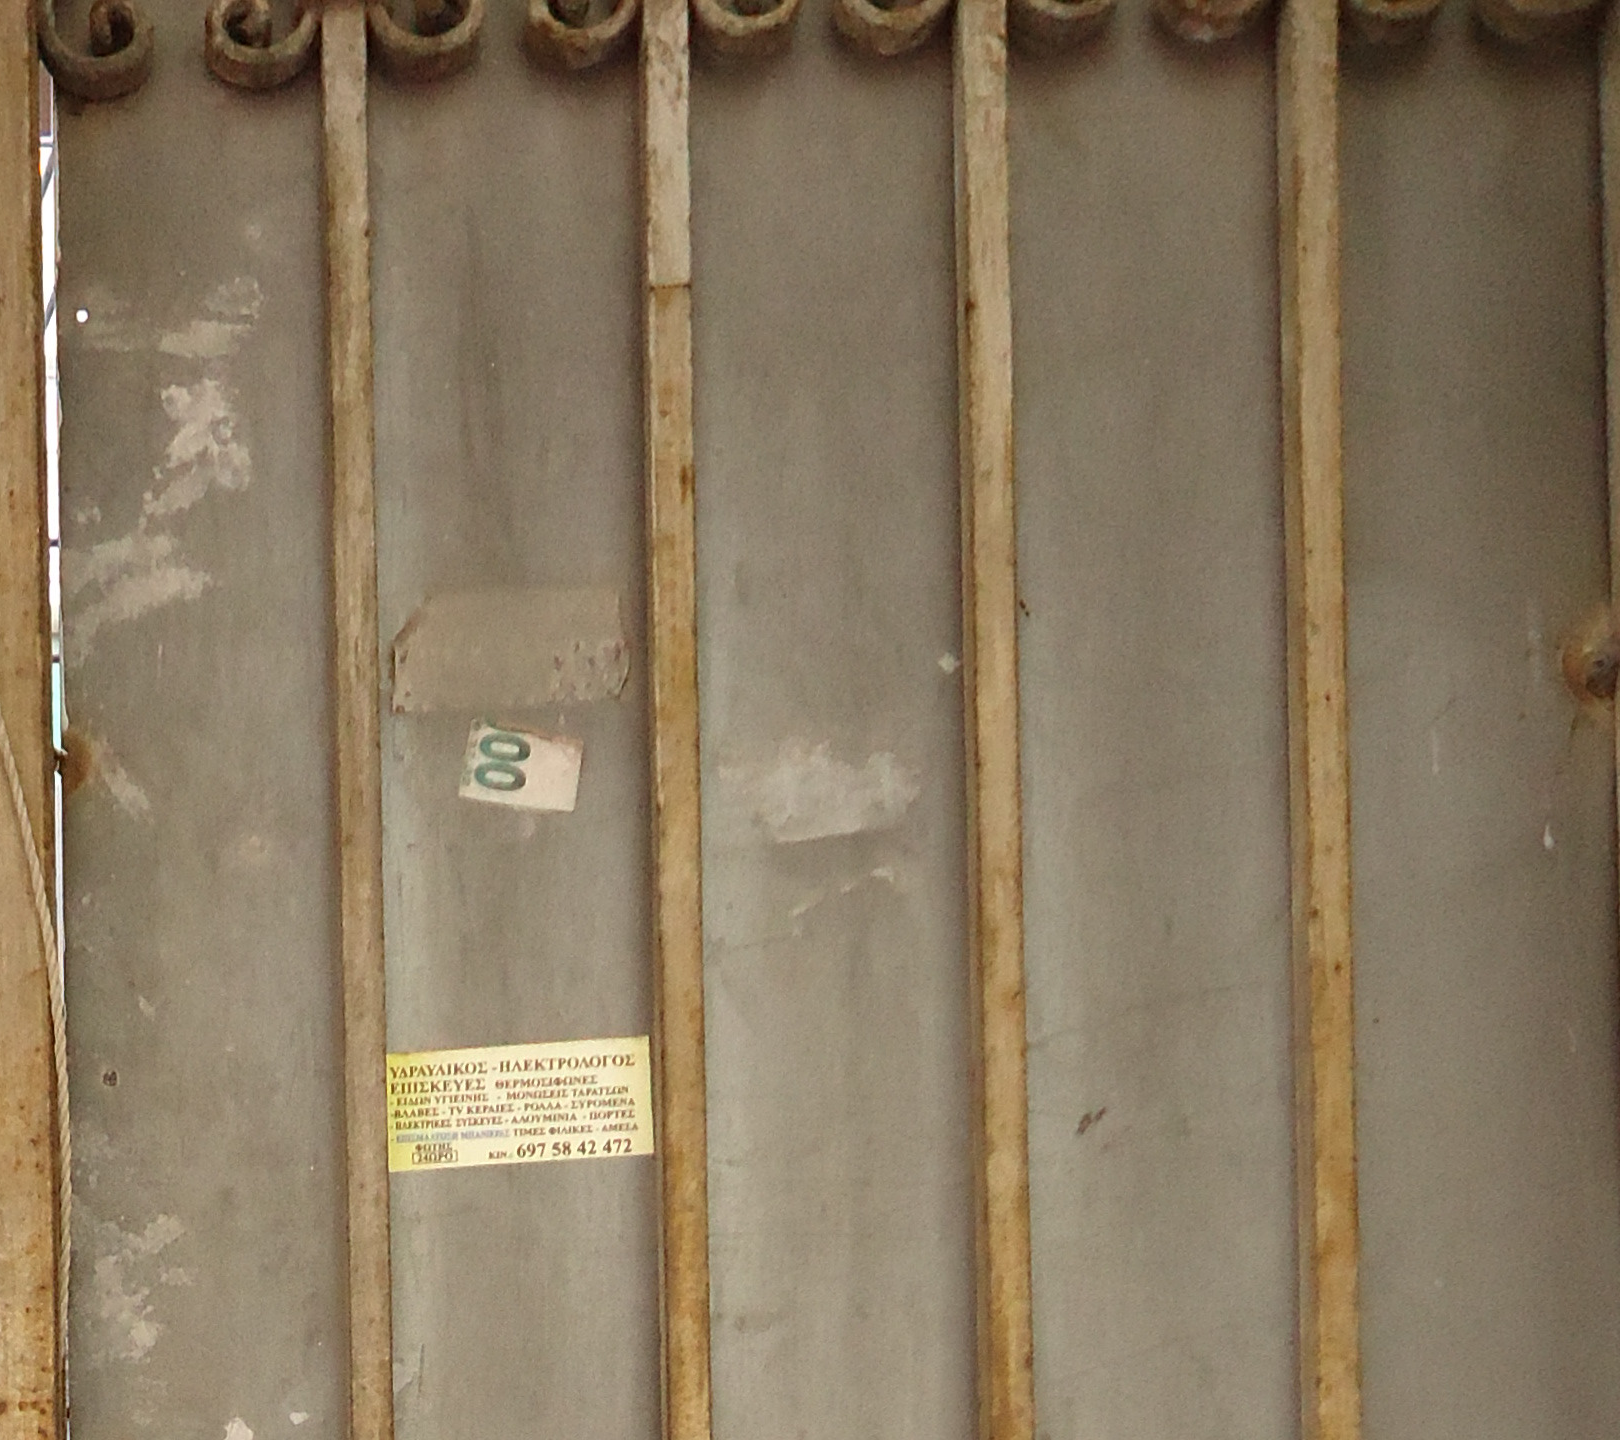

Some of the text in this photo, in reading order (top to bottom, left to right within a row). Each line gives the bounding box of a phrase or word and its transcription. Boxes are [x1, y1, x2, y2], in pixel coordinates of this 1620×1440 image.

[390, 1061, 488, 1079] ΥΔΡΑΥΛΙΚΟΣ
[390, 1075, 597, 1095] ΕΠΙΣΚΕΥΕΣ ΘΕΡΜΟΣΙΦΩΝΕΣ
[506, 1089, 568, 1101] ΜΟΝΩΣΕΙΣ
[466, 1104, 514, 1115] ΚΕΡΑΙΕΣ
[571, 1097, 635, 1110] ΣΥΡΟΜΕΝΑ
[511, 1112, 577, 1124] ΑΛΟΥΜΙΝΙΑ
[589, 1110, 635, 1121] ΠΟΡΤΕΣ
[513, 1126, 546, 1137] ΤΙΜΕΣ
[548, 1124, 593, 1135] ΦΙΛΙΚΕΣ
[601, 1122, 638, 1132] ΑΜΕΣΑ
[516, 1142, 546, 1158] 697
[552, 1141, 572, 1156] 58
[577, 1140, 596, 1155] 42
[603, 1138, 632, 1154] 472
